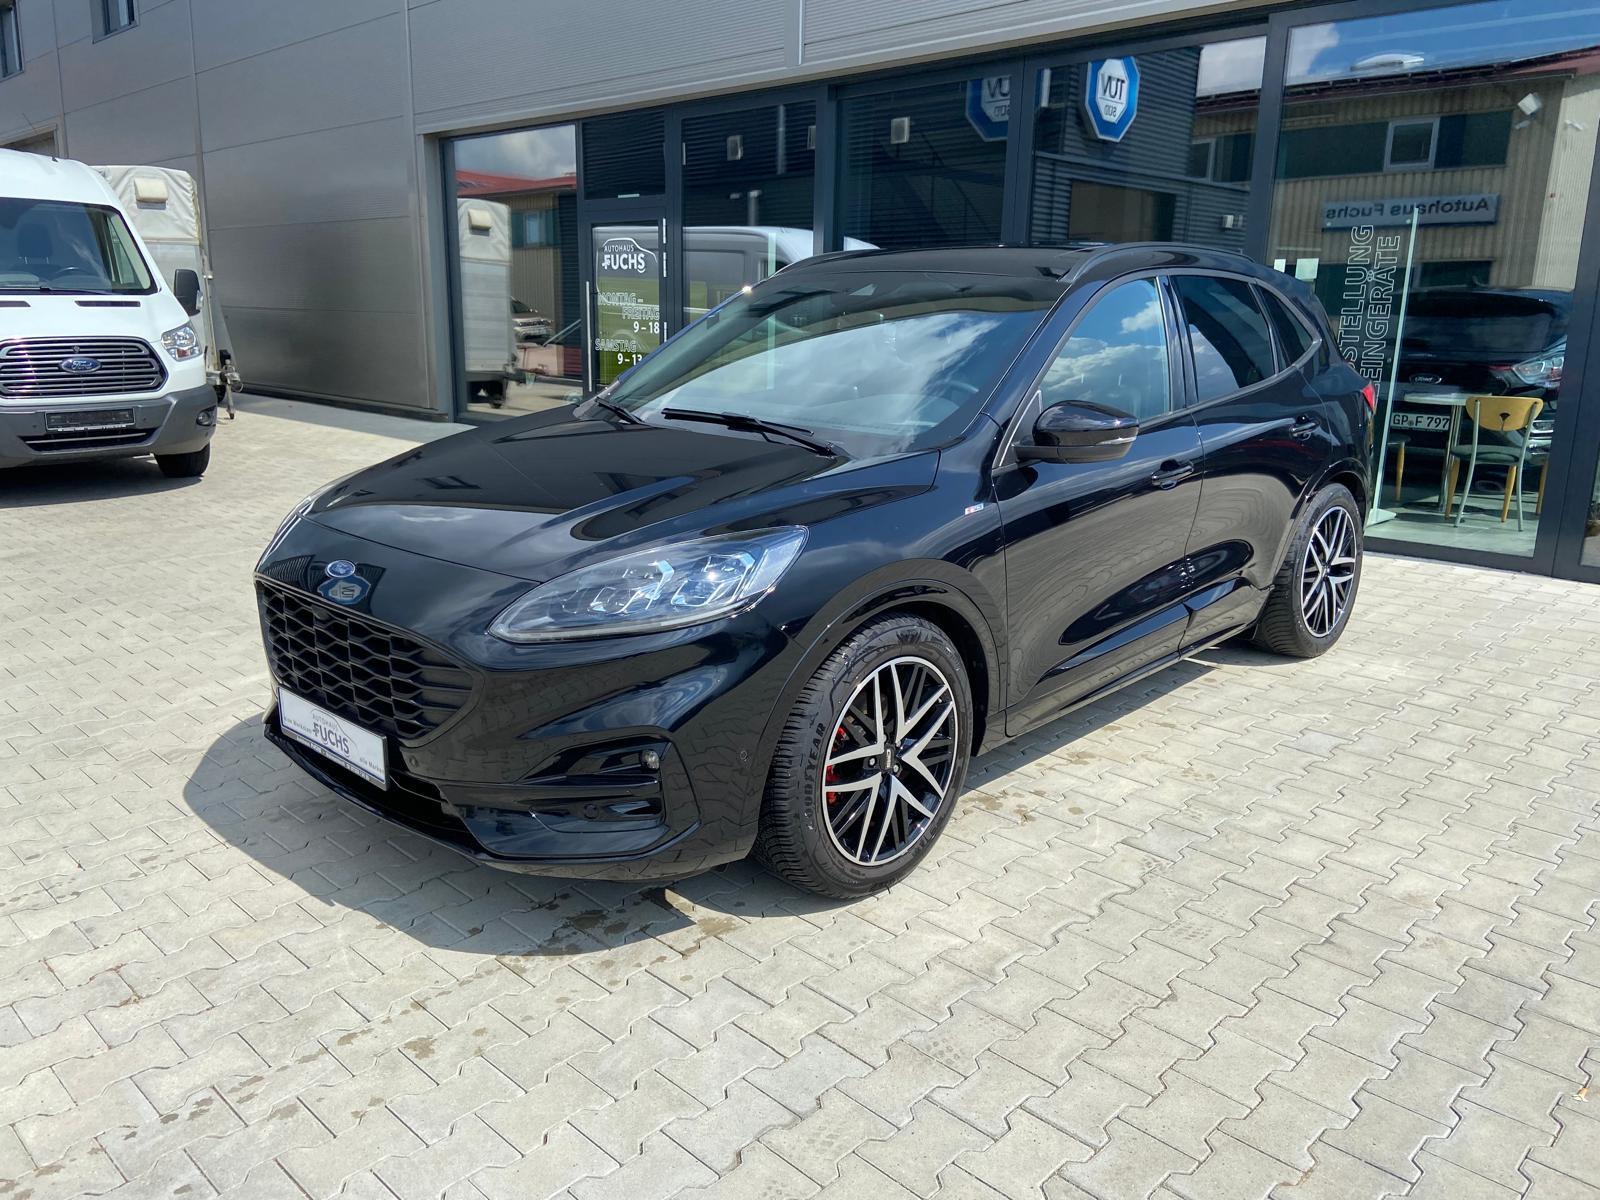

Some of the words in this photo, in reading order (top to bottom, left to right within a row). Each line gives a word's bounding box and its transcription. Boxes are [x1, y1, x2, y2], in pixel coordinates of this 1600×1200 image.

[603, 244, 635, 252] AUTOHAUS
[601, 253, 646, 271] FUCHS
[597, 292, 637, 306] MONTAG
[1337, 224, 1374, 369] STELLUNG
[622, 307, 660, 320] FREITAG
[595, 338, 637, 353] SAMSTAG
[1393, 414, 1408, 426] GP
[1415, 415, 1424, 427] F
[1427, 416, 1450, 429] 797
[312, 722, 350, 755] FUCHS
